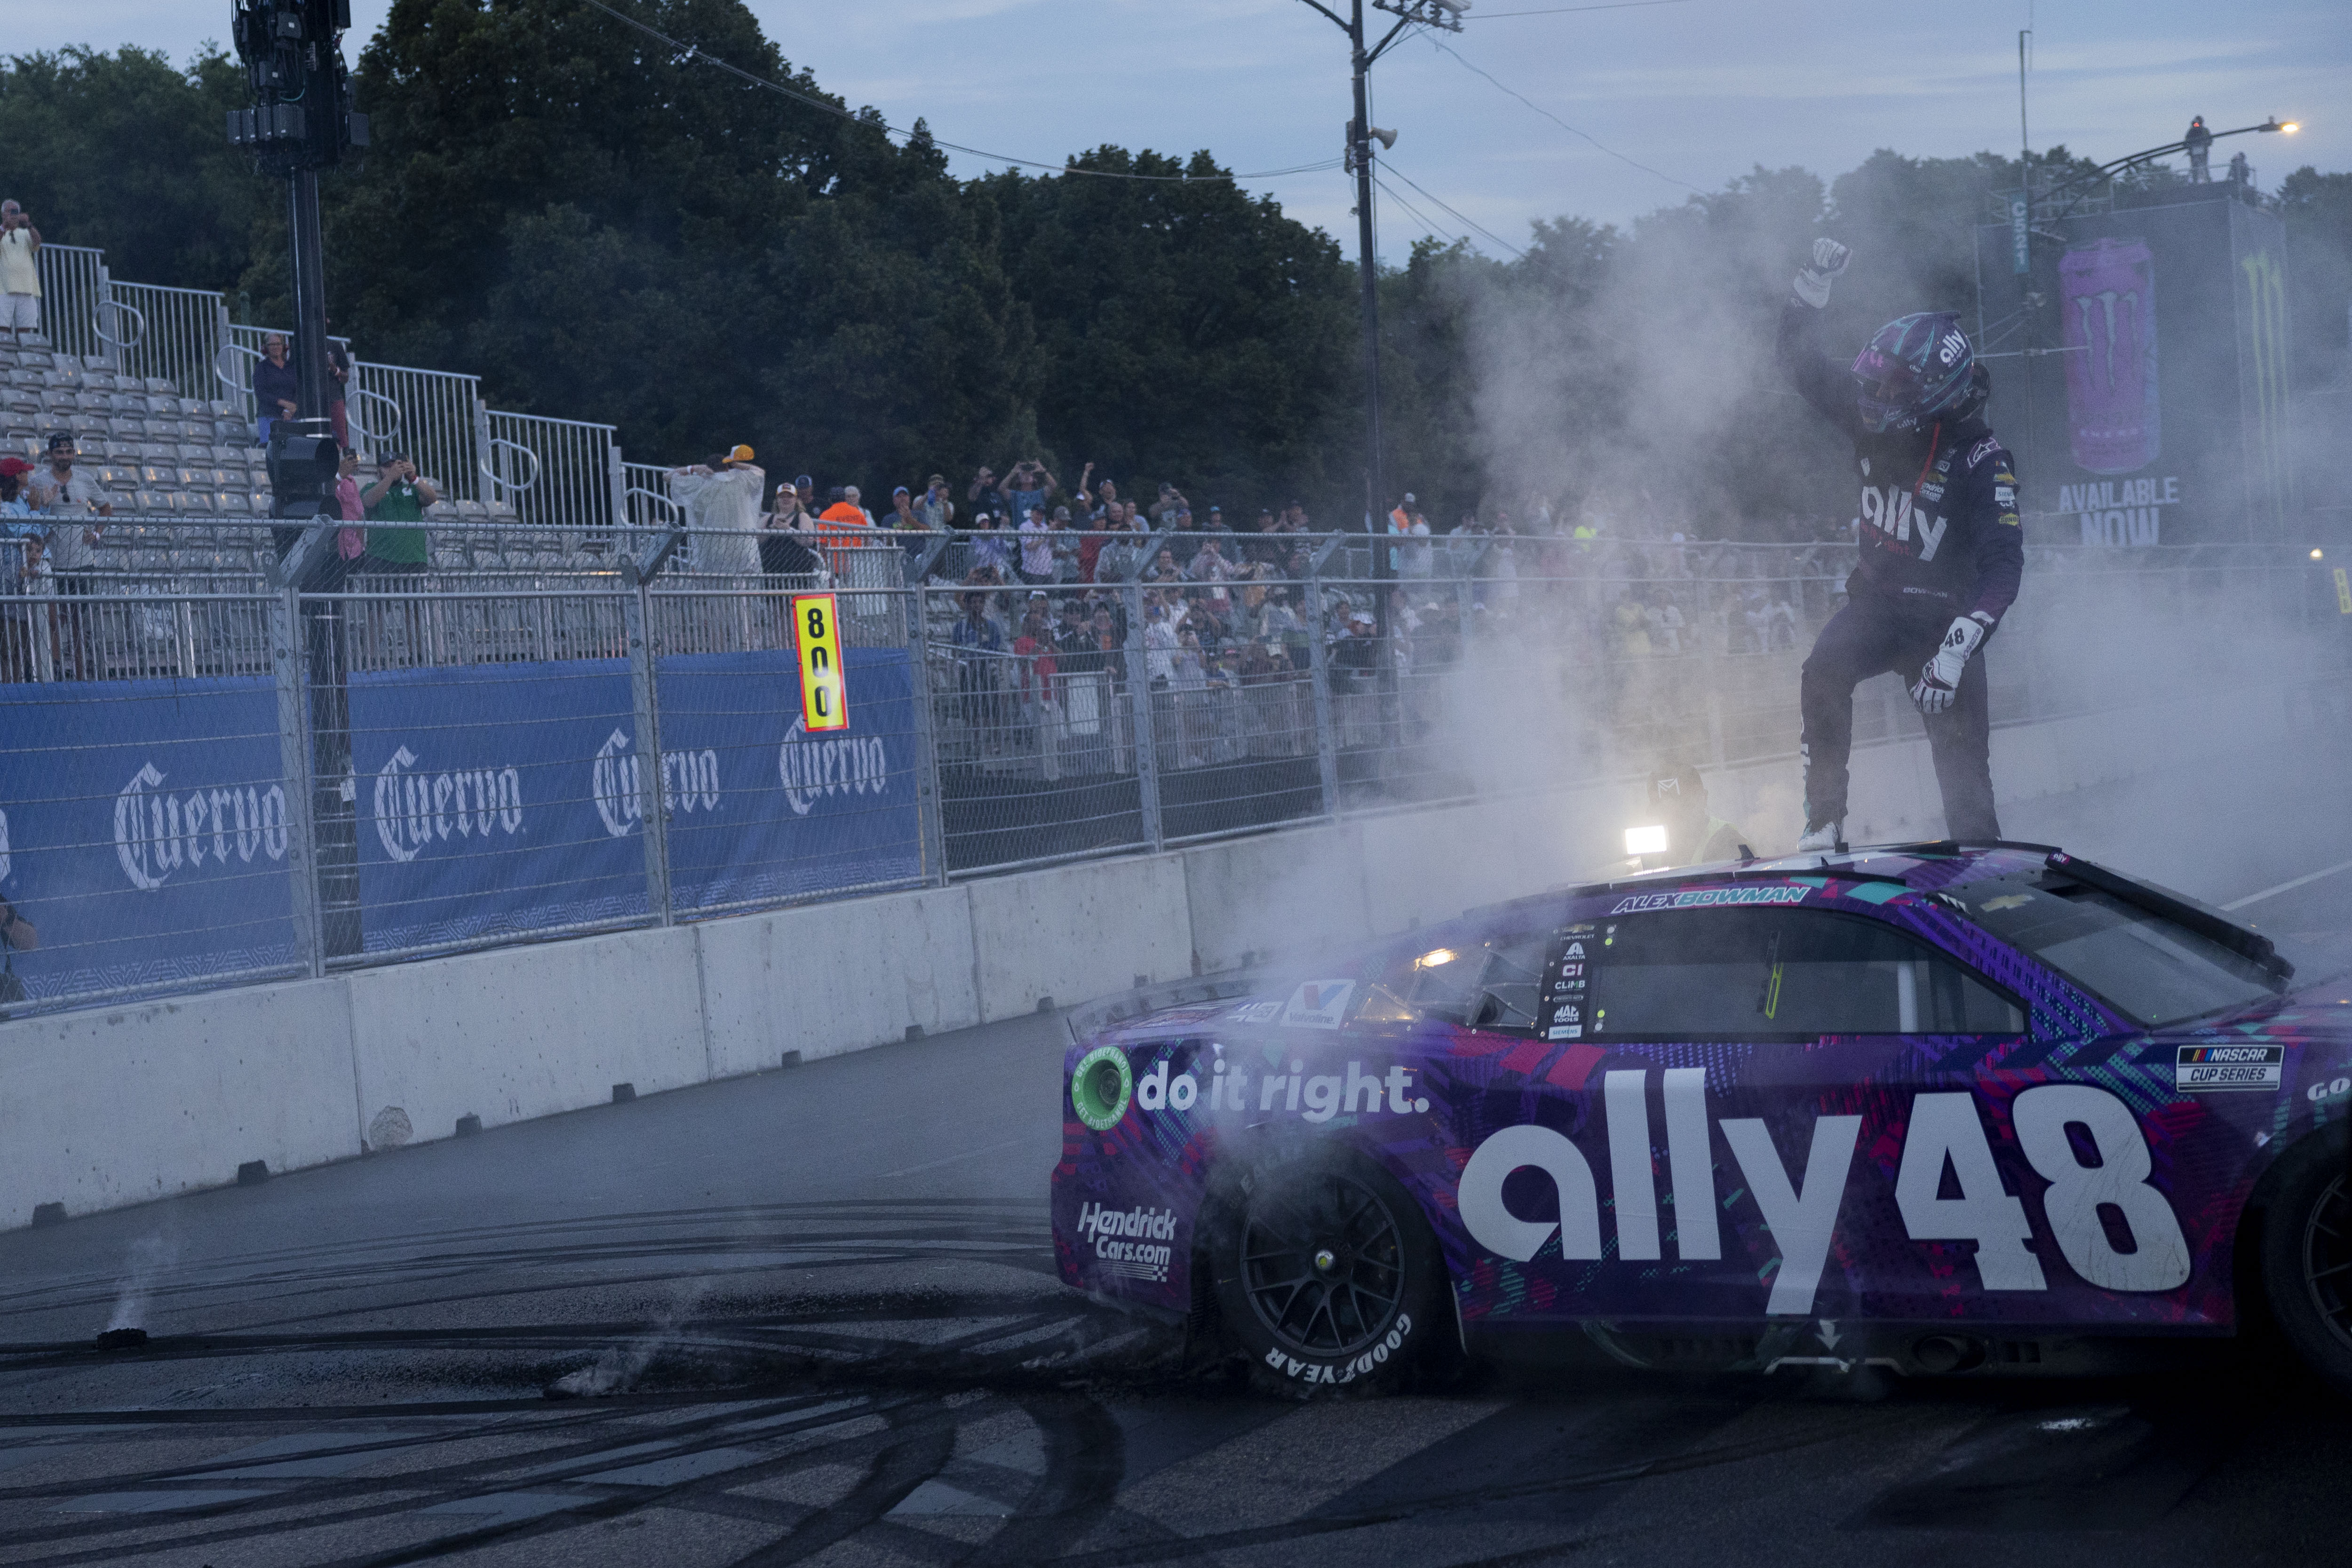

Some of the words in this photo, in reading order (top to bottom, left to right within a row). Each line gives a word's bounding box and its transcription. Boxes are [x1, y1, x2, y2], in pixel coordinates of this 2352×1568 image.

[1940, 329, 1966, 363] ally
[2059, 476, 2180, 512] AVAILABLE
[1862, 486, 1948, 562] ally
[2080, 507, 2159, 546] NOW
[1945, 628, 1965, 648] 48
[807, 608, 832, 717] 800
[593, 728, 719, 837] Curvo
[779, 712, 886, 815] Cuervo
[374, 744, 522, 862] Cuervo
[114, 760, 287, 893] Cuervo
[2190, 1068, 2218, 1082] CUP
[2218, 1067, 2267, 1081] SERIES
[2210, 1049, 2268, 1062] NASCAR
[1077, 1102, 1089, 1119] GET
[1137, 1060, 1198, 1111] do
[1210, 1059, 1249, 1111] it
[1259, 1059, 1430, 1123] right.
[1458, 1067, 1863, 1314] ally
[1894, 1084, 2191, 1292] 48
[1077, 1202, 1177, 1243] Hendrick
[1096, 1235, 1171, 1266] Cars.com
